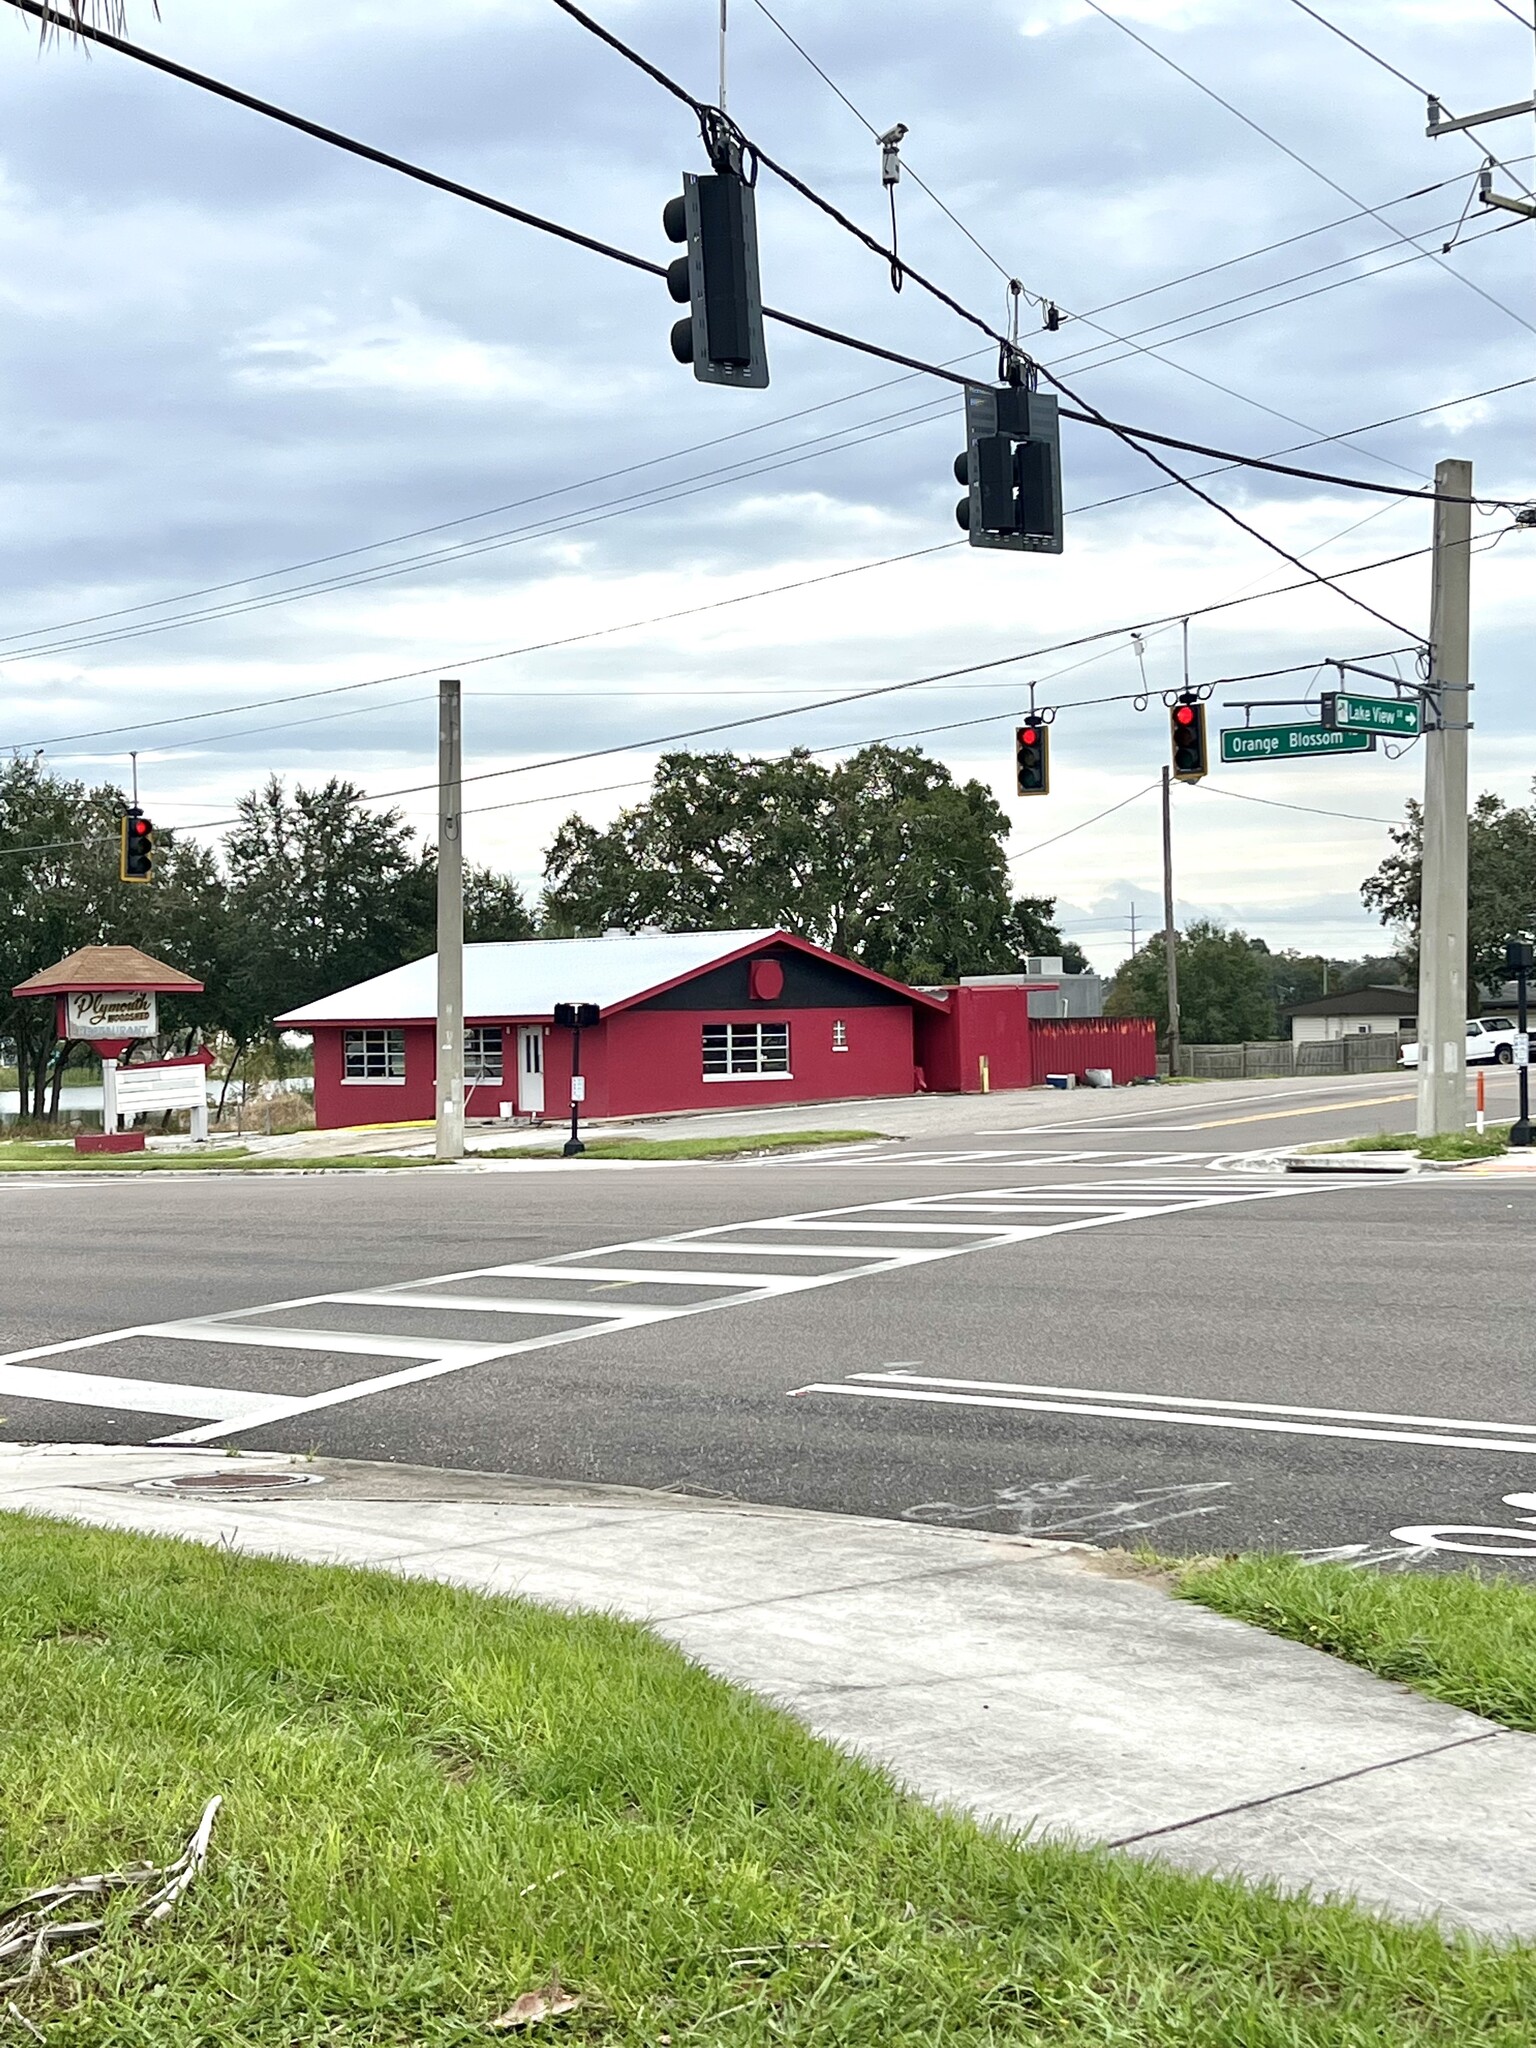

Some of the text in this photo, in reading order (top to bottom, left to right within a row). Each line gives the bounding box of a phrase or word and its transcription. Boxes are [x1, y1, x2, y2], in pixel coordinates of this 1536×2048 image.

[1349, 704, 1371, 721] Lake
[1372, 706, 1395, 724] View
[1232, 731, 1343, 754] Orange Blossom
[74, 991, 151, 1025] Plymouth
